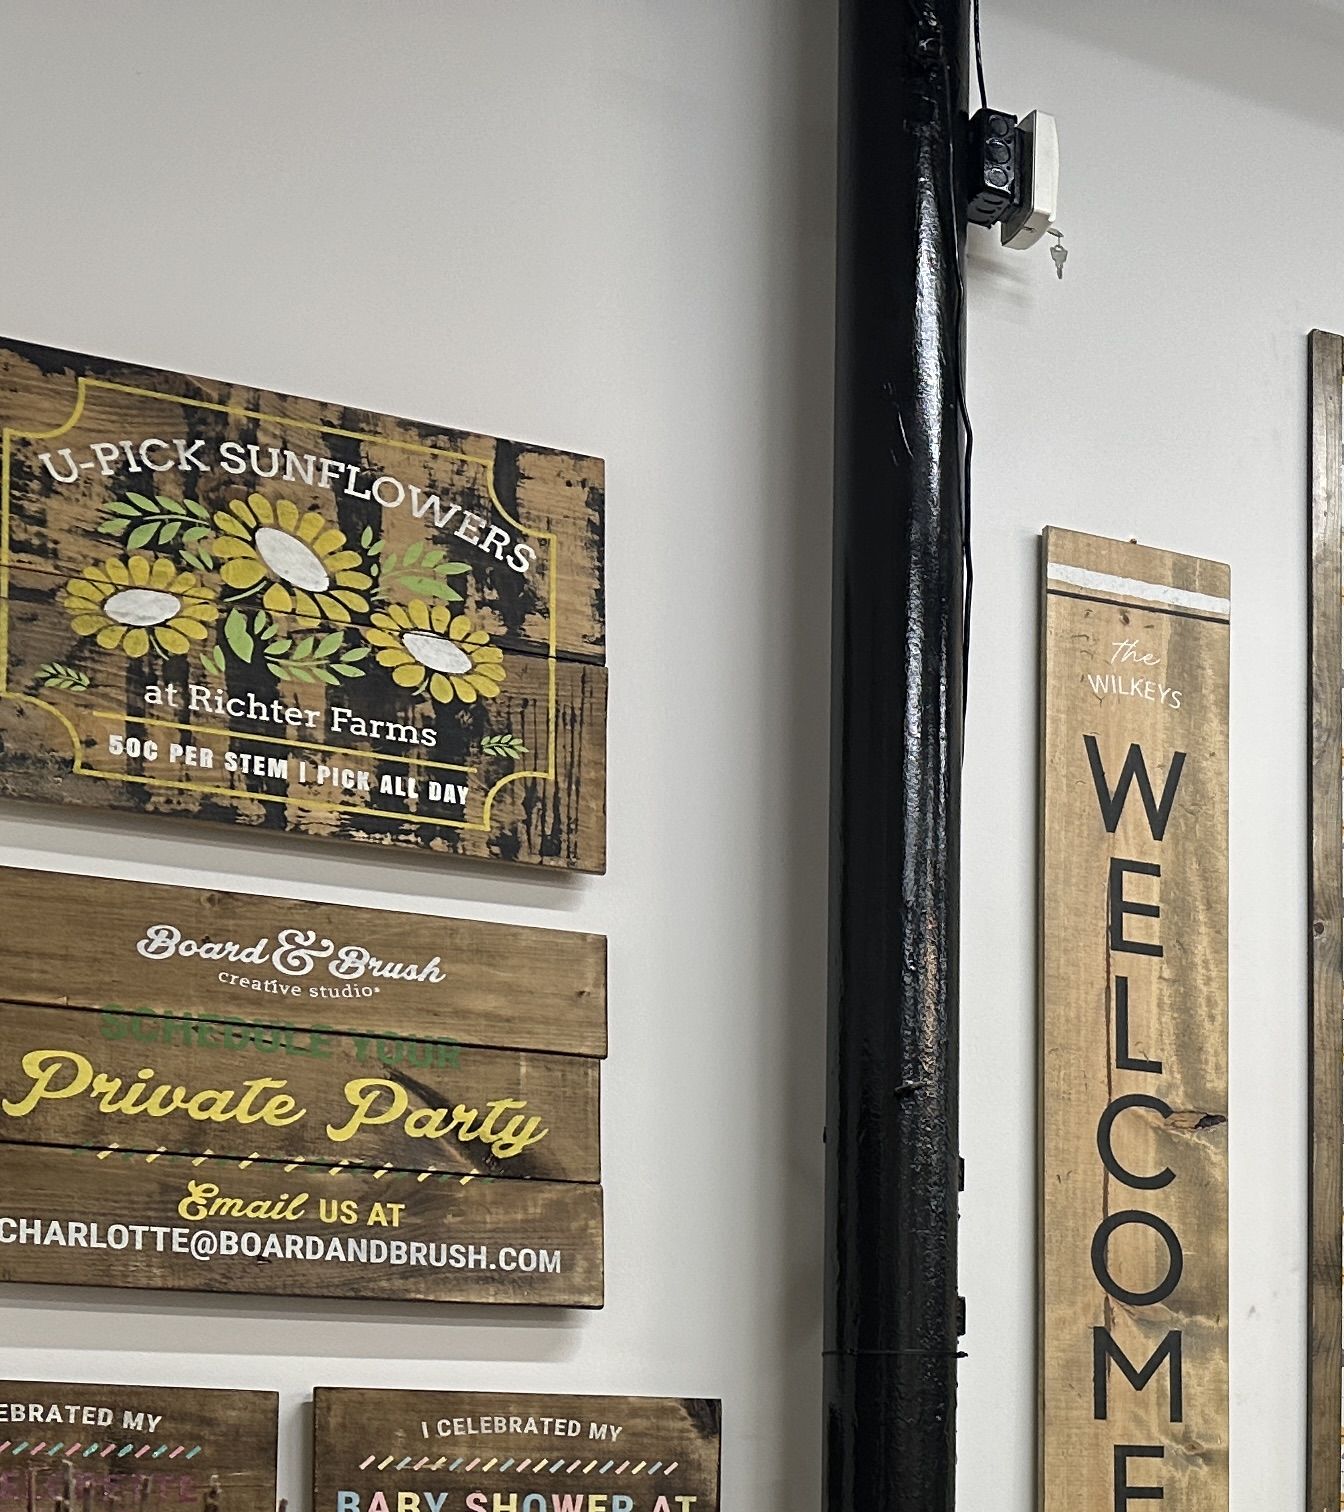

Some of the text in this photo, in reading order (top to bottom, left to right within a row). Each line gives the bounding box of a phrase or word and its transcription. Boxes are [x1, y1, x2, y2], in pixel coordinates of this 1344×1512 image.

[41, 438, 538, 575] U-PICK SUNFLOWERS
[1110, 639, 1160, 666] the
[143, 682, 439, 750] at Richter Farms
[1087, 674, 1183, 709] WILKEYS
[169, 742, 214, 770] PER
[224, 750, 289, 781] STEM
[317, 764, 370, 792] PICK
[380, 774, 419, 800] ALL
[428, 781, 470, 806] DAY
[136, 924, 448, 984] Board & Brush
[218, 970, 302, 997] creative
[100, 1002, 463, 1070] SCHEDULE YOUR
[2, 1048, 549, 1160] Private Party
[177, 1179, 407, 1229] Email US AT
[0, 1216, 563, 1276] CHARLOTTE@BOARDANDBRUSH.COM
[122, 1410, 163, 1433] MY
[437, 1416, 582, 1438] CELEBRATED
[589, 1422, 624, 1443] MY
